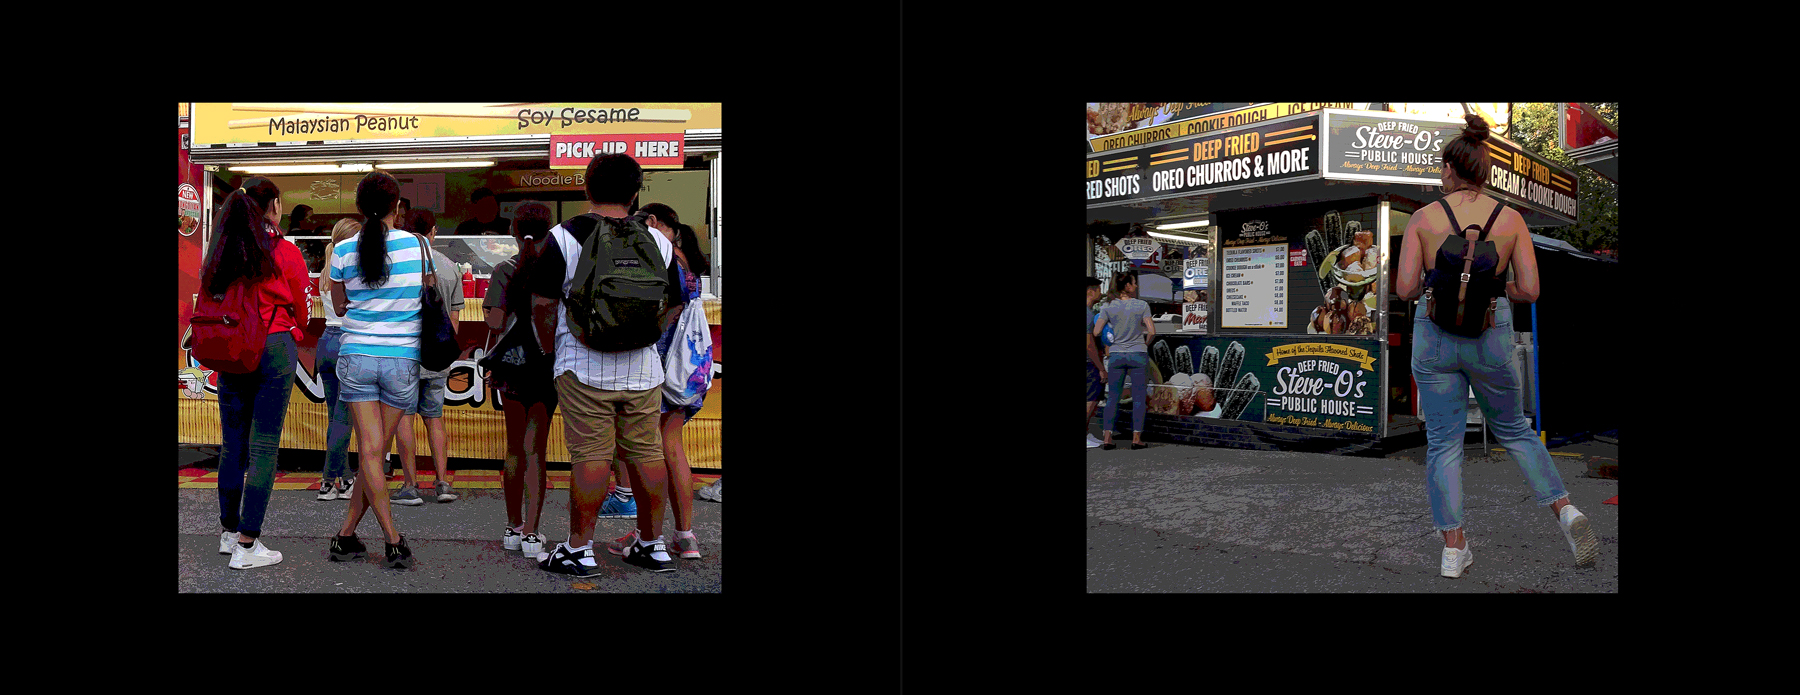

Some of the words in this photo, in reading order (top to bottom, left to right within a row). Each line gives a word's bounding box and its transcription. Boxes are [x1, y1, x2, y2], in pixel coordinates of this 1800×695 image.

[269, 116, 349, 135] Malaysian
[355, 115, 418, 133] Peanut
[517, 109, 553, 129] Soy
[560, 107, 639, 128] Sesame
[1127, 104, 1159, 126] Always
[1377, 121, 1397, 132] DEEP
[1398, 121, 1419, 135] FRIED
[1193, 138, 1222, 162] DEEP
[1225, 132, 1260, 157] FRIED
[1351, 126, 1444, 152] Steve-O's
[556, 141, 627, 158] PICK-UP
[635, 141, 679, 157] HERE
[1361, 149, 1398, 163] PUBLIC
[1401, 152, 1434, 165] HOUSE
[1152, 167, 1184, 192] OREO
[1187, 156, 1251, 187] CHURROS
[1254, 155, 1265, 178] &
[1267, 147, 1310, 176] MORE
[1513, 152, 1531, 177] DEEP
[1532, 161, 1550, 185] FRIED
[520, 174, 572, 187] Noodle
[1104, 173, 1140, 198] SHOTS
[1491, 164, 1520, 196] CREAM
[1520, 177, 1527, 198] &
[1528, 180, 1554, 208] COOKIE
[1554, 191, 1577, 217] DOUGH
[1122, 245, 1154, 254] OREO
[1184, 267, 1208, 279] ORE
[1184, 312, 1208, 326] Mar
[1276, 347, 1291, 357] Home
[1297, 359, 1316, 374] DEEP
[1317, 359, 1339, 376] FRIED
[1273, 366, 1367, 398] Steve-O's
[1281, 396, 1317, 414] PUBLIC
[1320, 399, 1356, 417] HOUSE
[1267, 413, 1287, 425] Always
[1287, 414, 1301, 427] Deep
[1301, 416, 1317, 427] Fried
[1322, 418, 1345, 431] Always
[1345, 420, 1374, 432] Delicious
